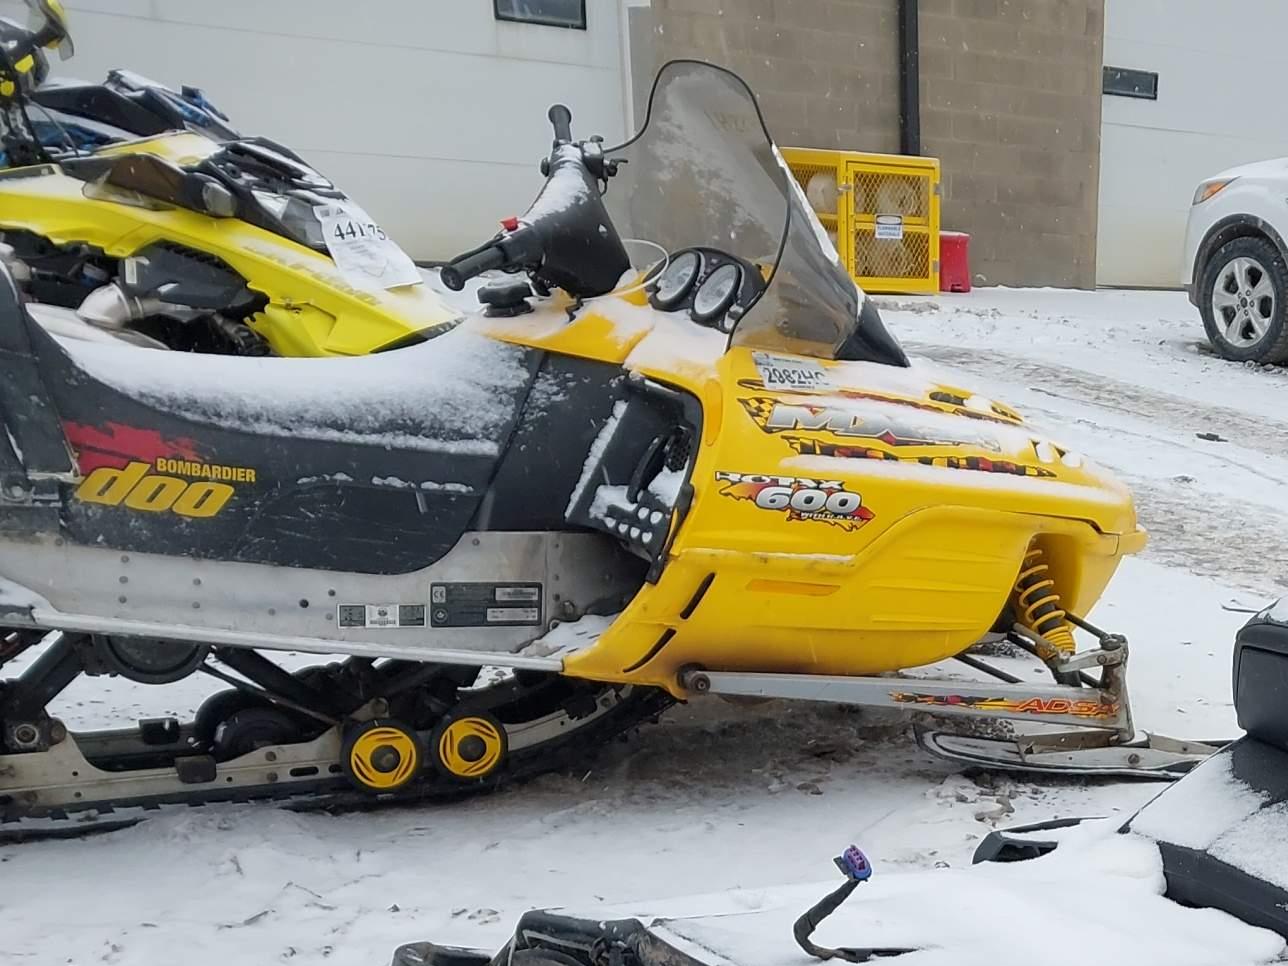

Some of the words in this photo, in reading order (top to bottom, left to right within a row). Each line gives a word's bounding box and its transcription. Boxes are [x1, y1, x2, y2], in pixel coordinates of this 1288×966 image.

[156, 457, 256, 482] BOMBARDIER
[75, 461, 235, 518] doo
[755, 486, 863, 513] 600
